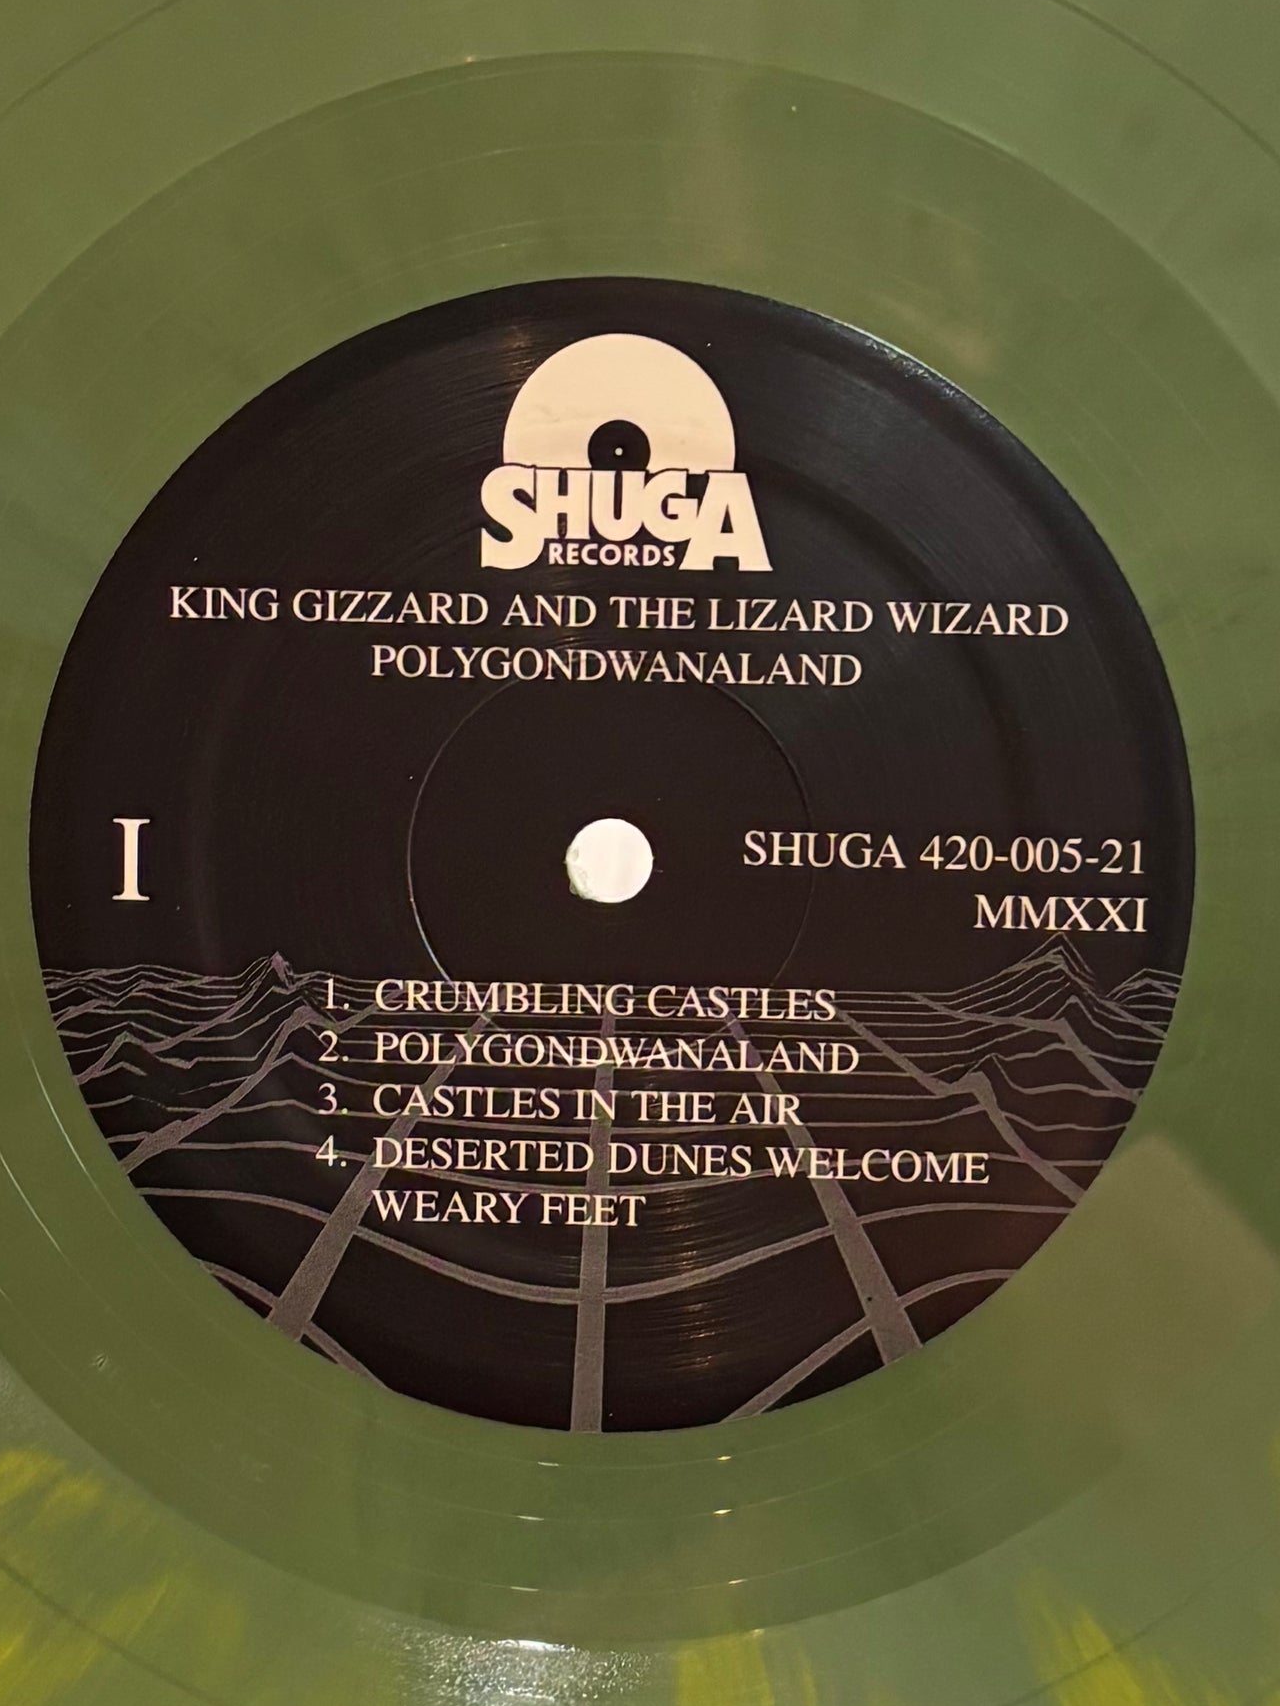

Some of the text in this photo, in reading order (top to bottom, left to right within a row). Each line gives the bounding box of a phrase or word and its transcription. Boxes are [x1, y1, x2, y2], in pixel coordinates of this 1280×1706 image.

[480, 463, 774, 572] SHUGA
[548, 538, 678, 568] RECORDS
[170, 585, 1070, 637] KING GIZZARD AND THE LIZARD WIZARD
[371, 644, 863, 687] POLYGONDWANALAND
[743, 829, 1142, 875] SHUGA 420-005-21
[973, 893, 1147, 933] MMXXI
[324, 977, 837, 1022] 1. CRUMBLING CASTLES
[317, 1029, 860, 1075] 2. POLYGONDWANALAND
[317, 1081, 805, 1127] 3. CASTLES IN THE AIR
[314, 1134, 990, 1185] 4. DESERTED DUNES WELCOME
[370, 1188, 647, 1227] WEARY FEET
